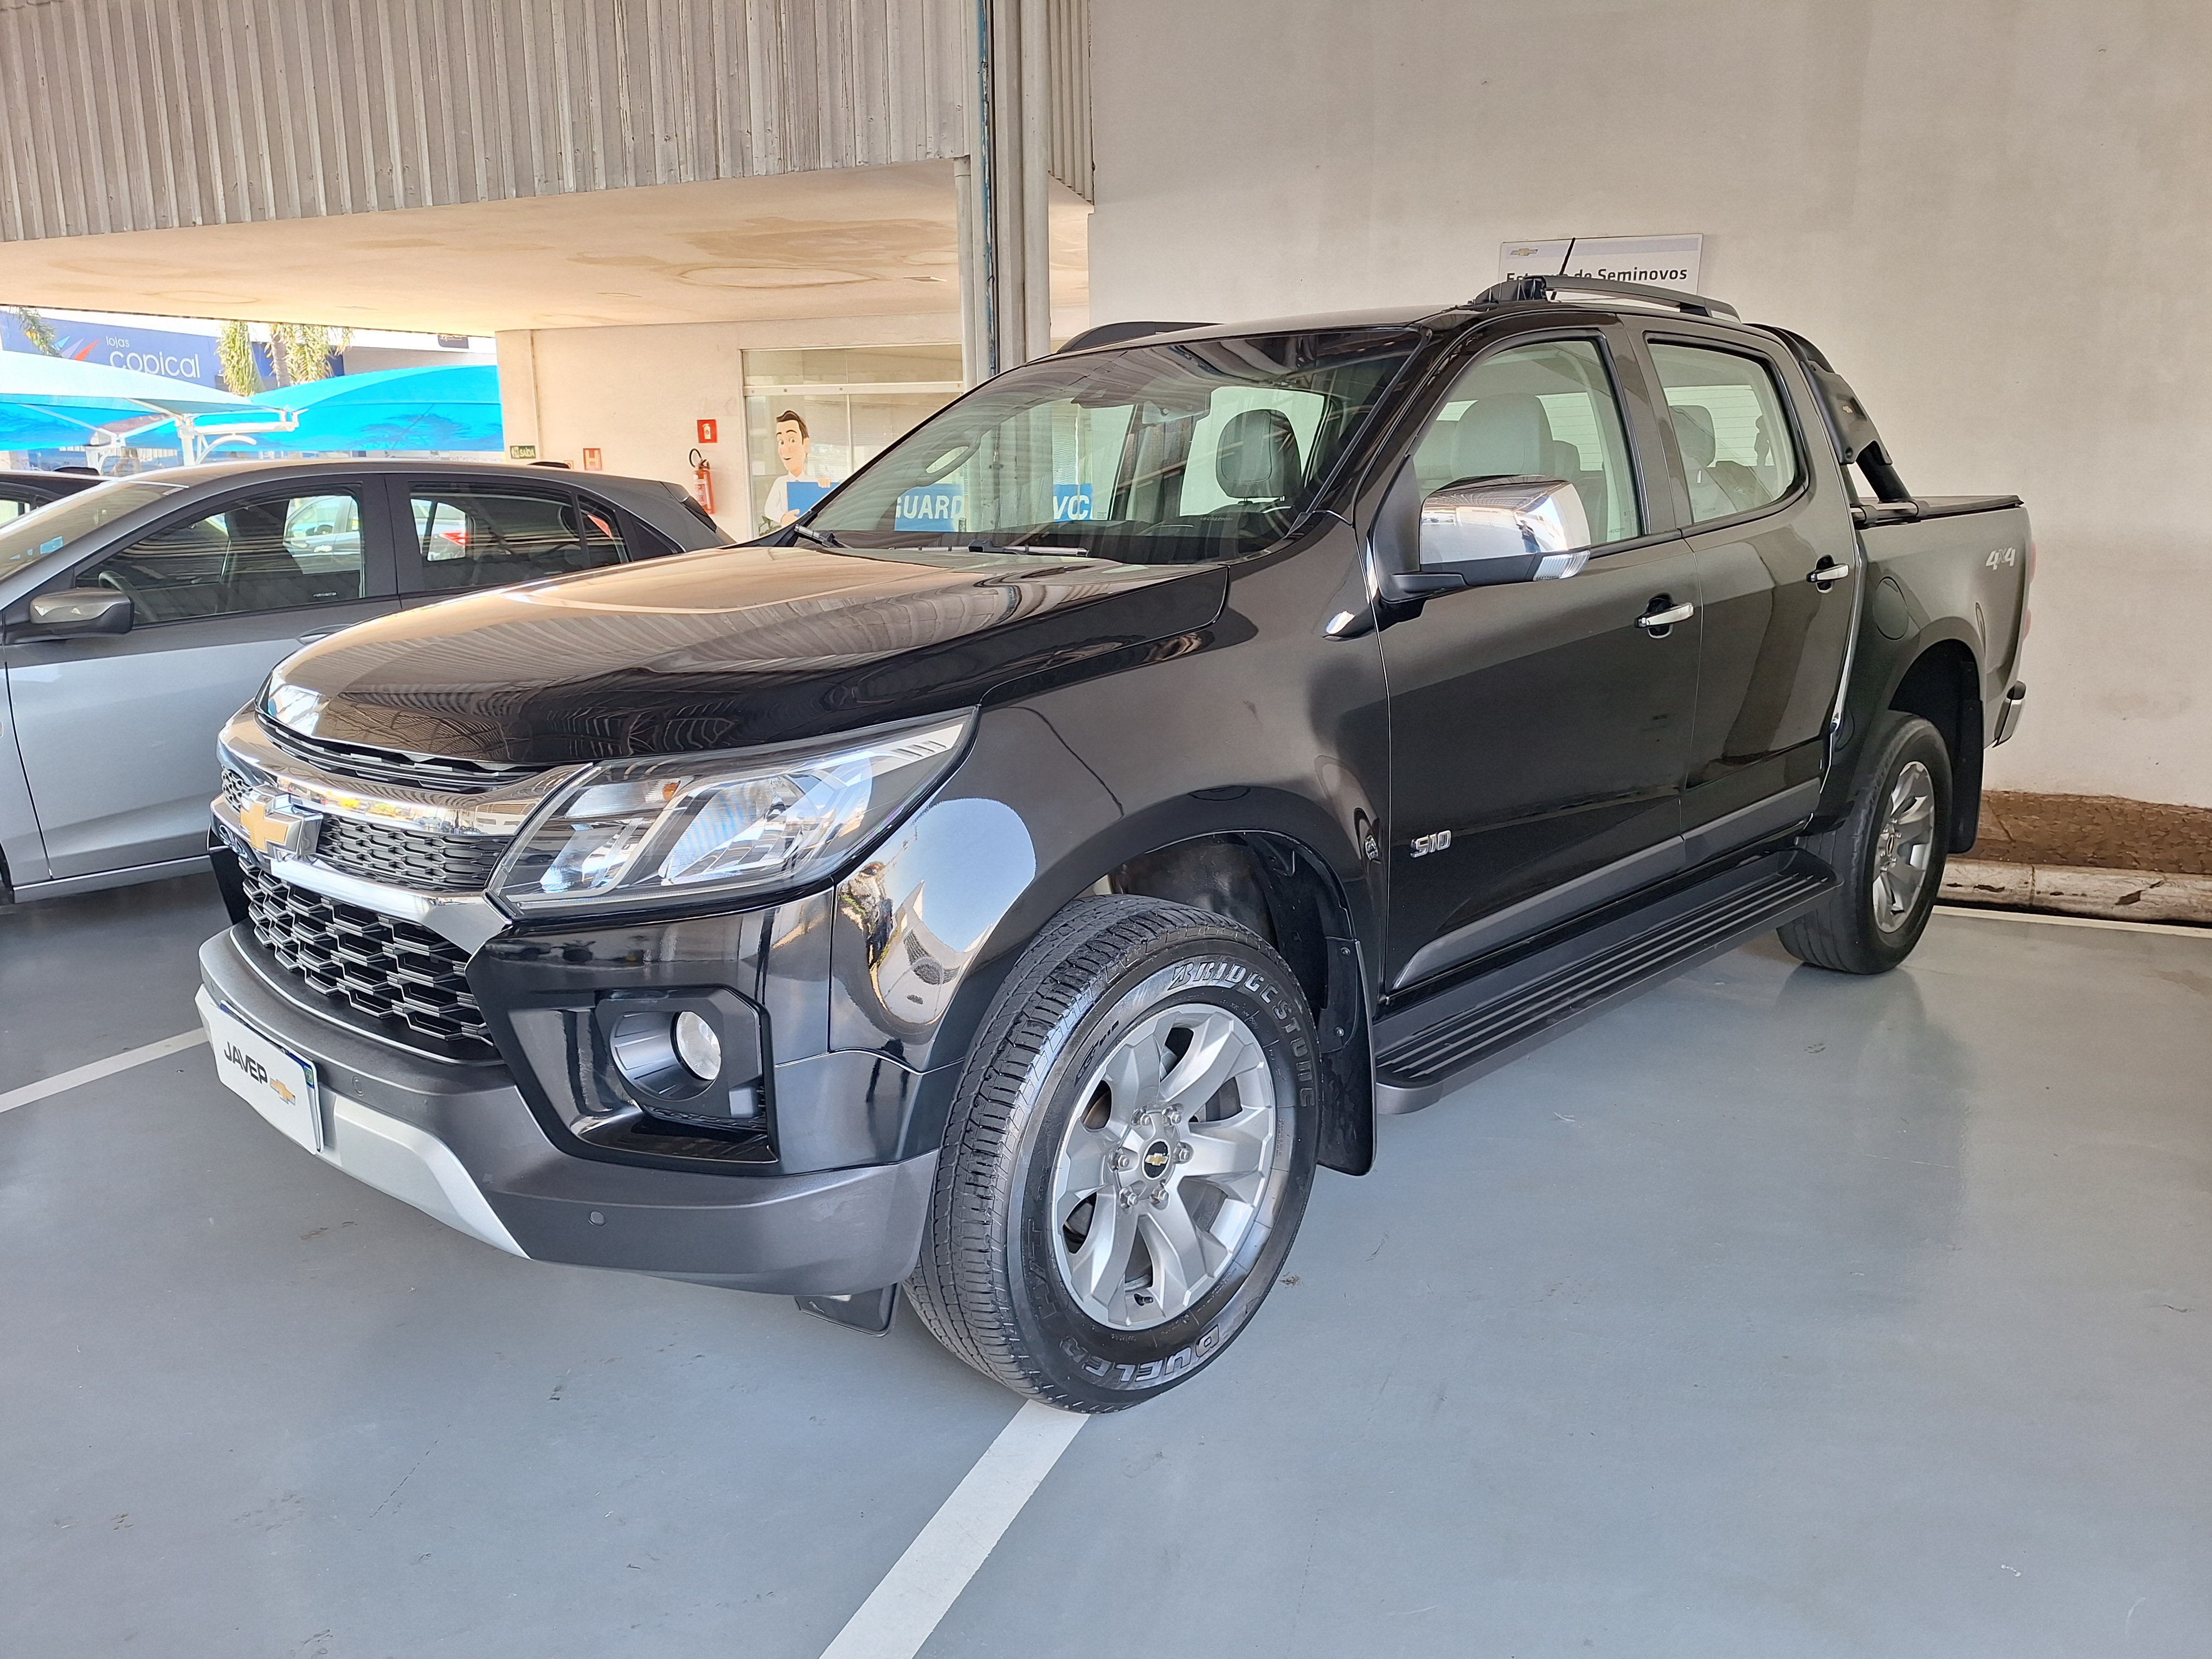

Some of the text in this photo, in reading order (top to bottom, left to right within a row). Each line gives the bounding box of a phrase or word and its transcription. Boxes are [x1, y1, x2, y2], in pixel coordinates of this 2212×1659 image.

[1597, 266, 1687, 281] Seminovos
[106, 336, 130, 349] lojas
[1410, 830, 1451, 858] S10
[1167, 961, 1315, 1107] BRIDGESTONE
[223, 1041, 268, 1084] JAVER
